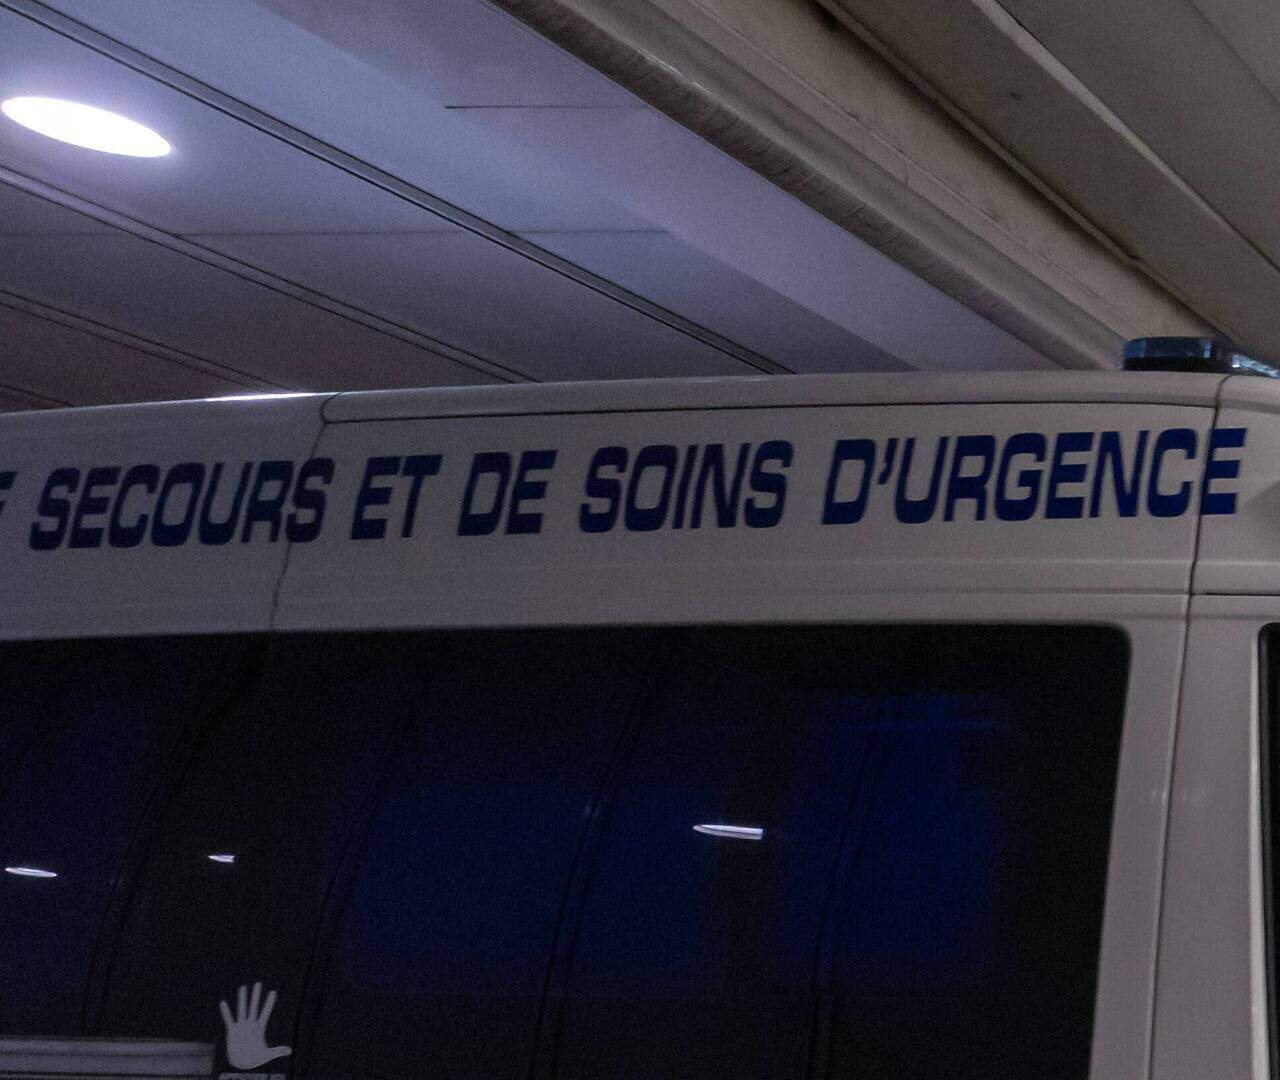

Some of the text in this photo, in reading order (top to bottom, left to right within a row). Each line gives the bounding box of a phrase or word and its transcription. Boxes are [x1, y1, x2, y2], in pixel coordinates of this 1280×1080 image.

[29, 457, 334, 551] SECOURS
[350, 453, 443, 541] ET
[457, 449, 558, 537] DE
[578, 440, 793, 534] SOINS
[822, 427, 1247, 525] D'URGENCE
